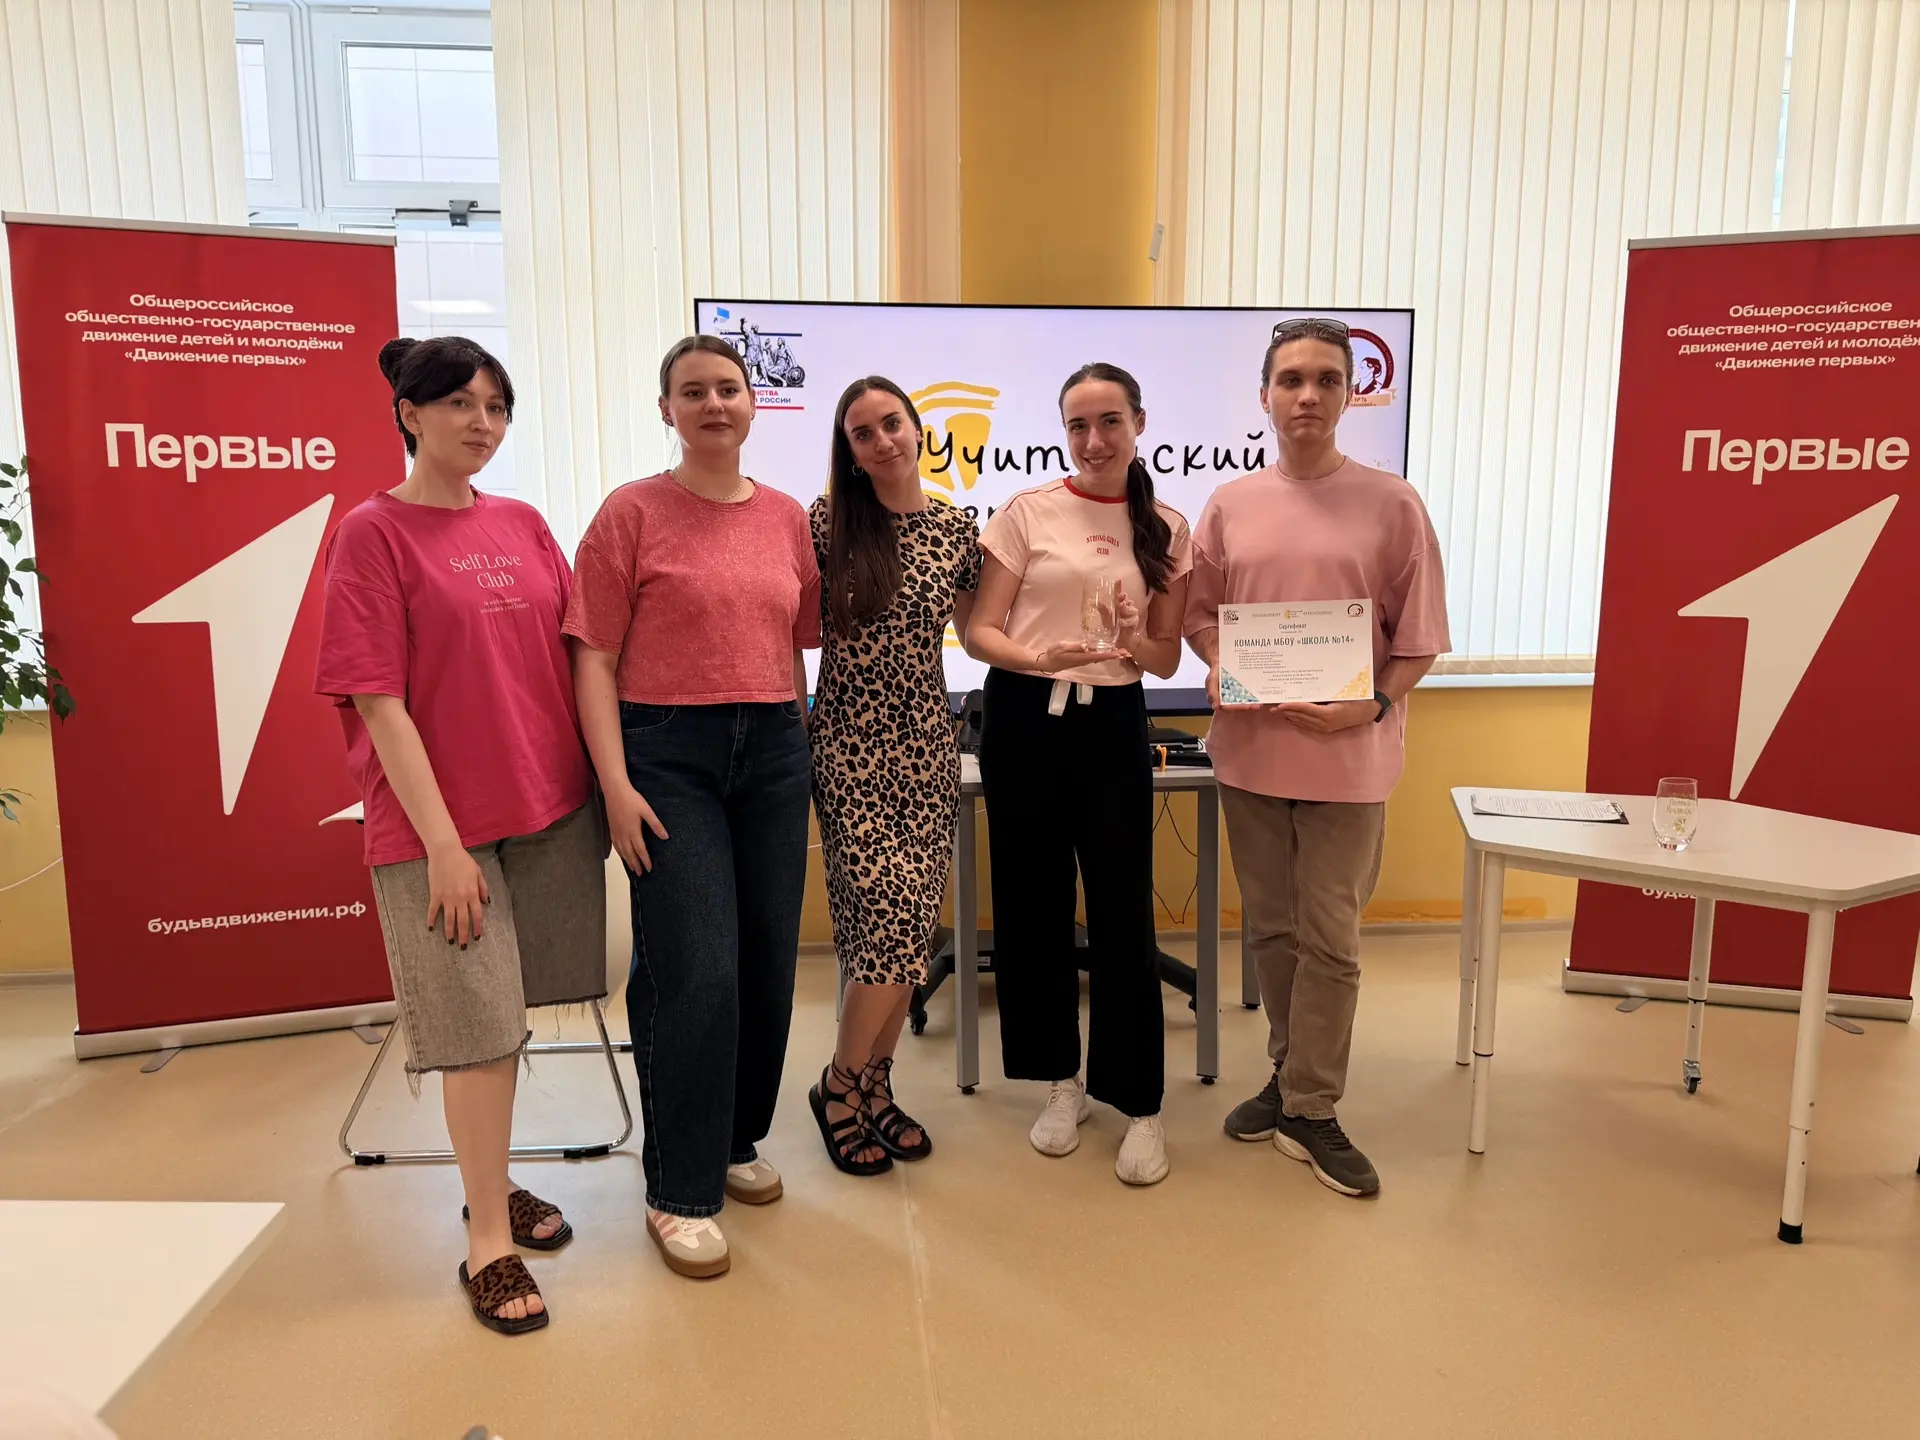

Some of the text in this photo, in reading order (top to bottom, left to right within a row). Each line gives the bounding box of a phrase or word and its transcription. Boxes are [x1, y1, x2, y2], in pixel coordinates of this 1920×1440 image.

[129, 293, 294, 314] Общероссийское
[1728, 301, 1893, 318] Общероссийское
[64, 309, 356, 334] общественно-государственное
[1666, 318, 1920, 337] общественно-государствен
[81, 330, 344, 351] движение детей и молодёжи
[1678, 334, 1920, 355] движение детей и молодё
[124, 348, 307, 367] «Движение первых»
[1715, 355, 1896, 371] «Движение первых»
[104, 422, 337, 482] Первые
[1681, 429, 1910, 486] Первые
[1096, 547, 1110, 555] CLUB
[449, 553, 523, 573] Self Love
[476, 571, 515, 589] Club
[1234, 637, 1271, 648] КОМАНДА
[1273, 636, 1295, 646] МБОУ
[1297, 636, 1330, 645] «ШКОЛА
[147, 900, 367, 935] будьвдвижении.рф
